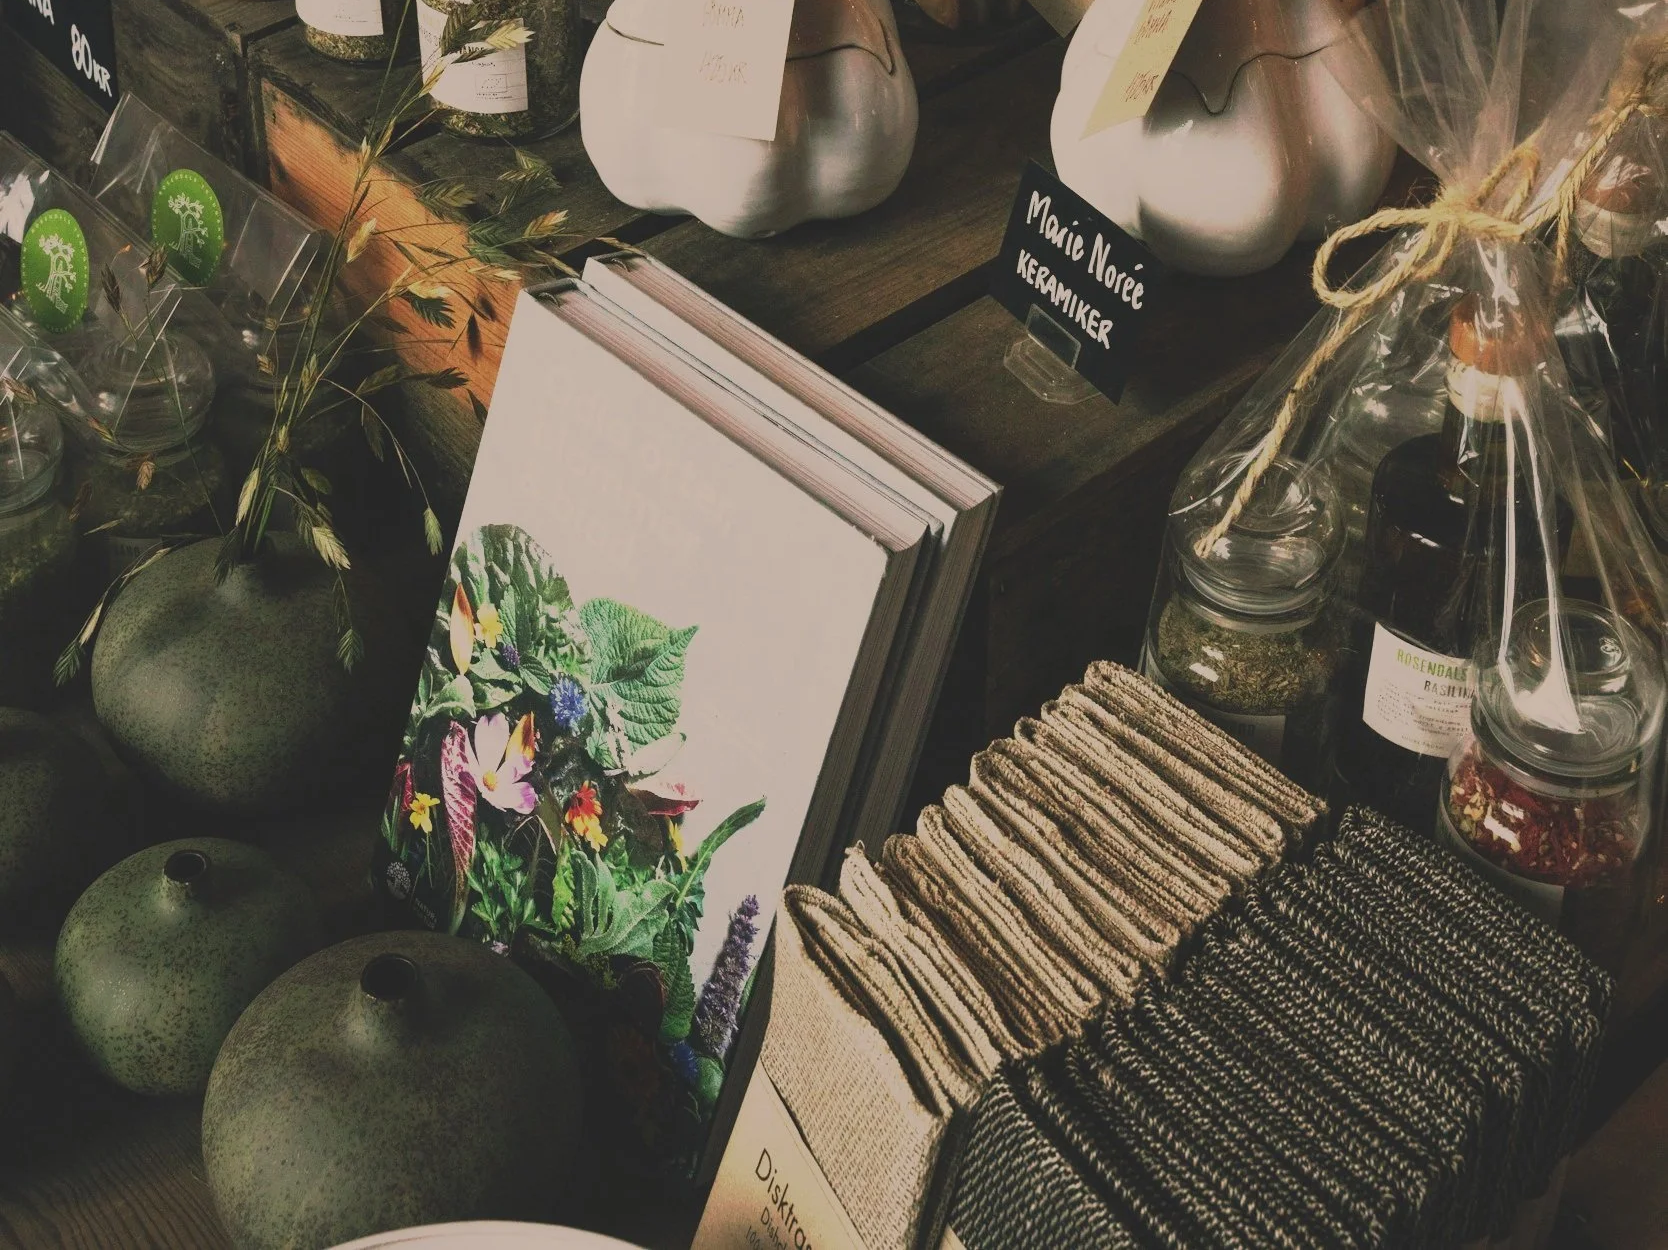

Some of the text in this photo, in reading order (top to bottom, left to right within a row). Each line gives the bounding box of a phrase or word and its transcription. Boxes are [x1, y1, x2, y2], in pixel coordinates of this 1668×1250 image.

[1016, 249, 1113, 350] KERAMIKER
[1026, 190, 1144, 310] Marie Norée
[1396, 648, 1467, 681] ROSENDALS
